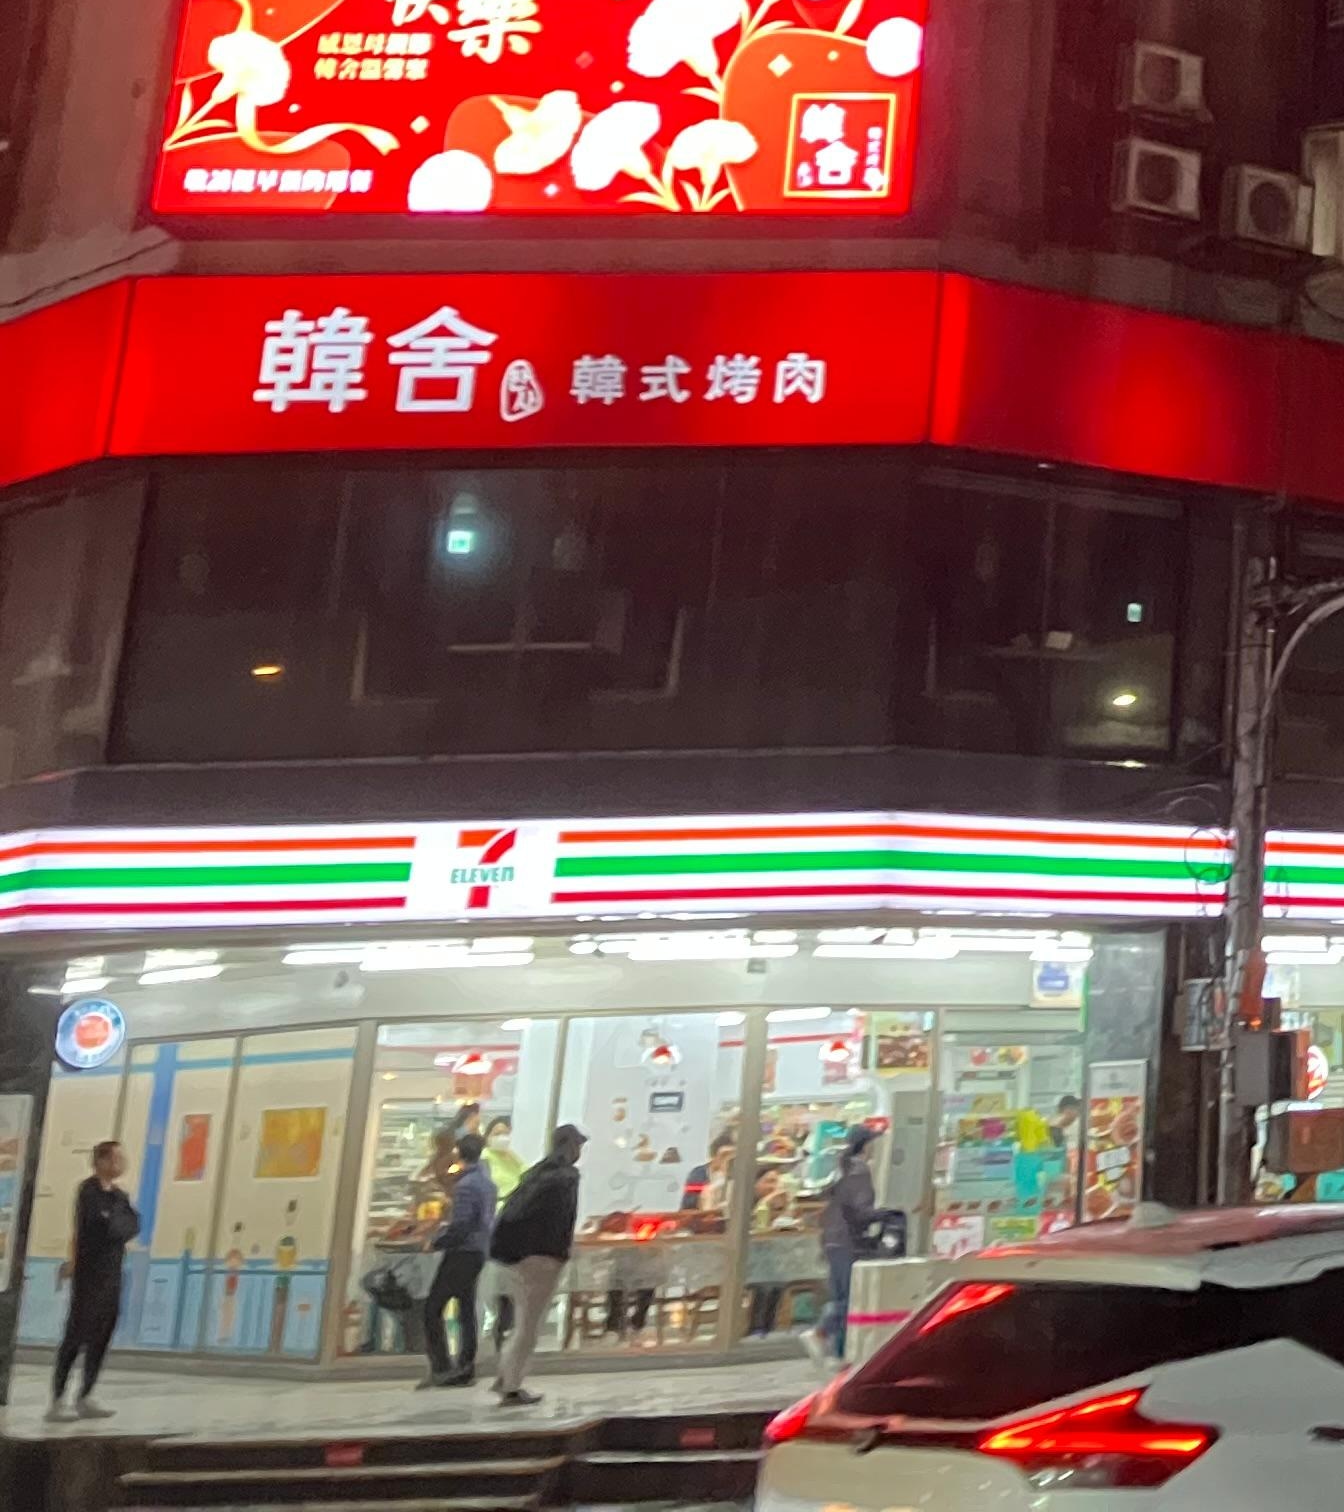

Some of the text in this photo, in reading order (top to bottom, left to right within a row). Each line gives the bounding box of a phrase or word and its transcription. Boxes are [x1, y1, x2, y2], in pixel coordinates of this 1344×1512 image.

[252, 303, 499, 415] 韓舍
[568, 350, 827, 407] 韓式烤肉
